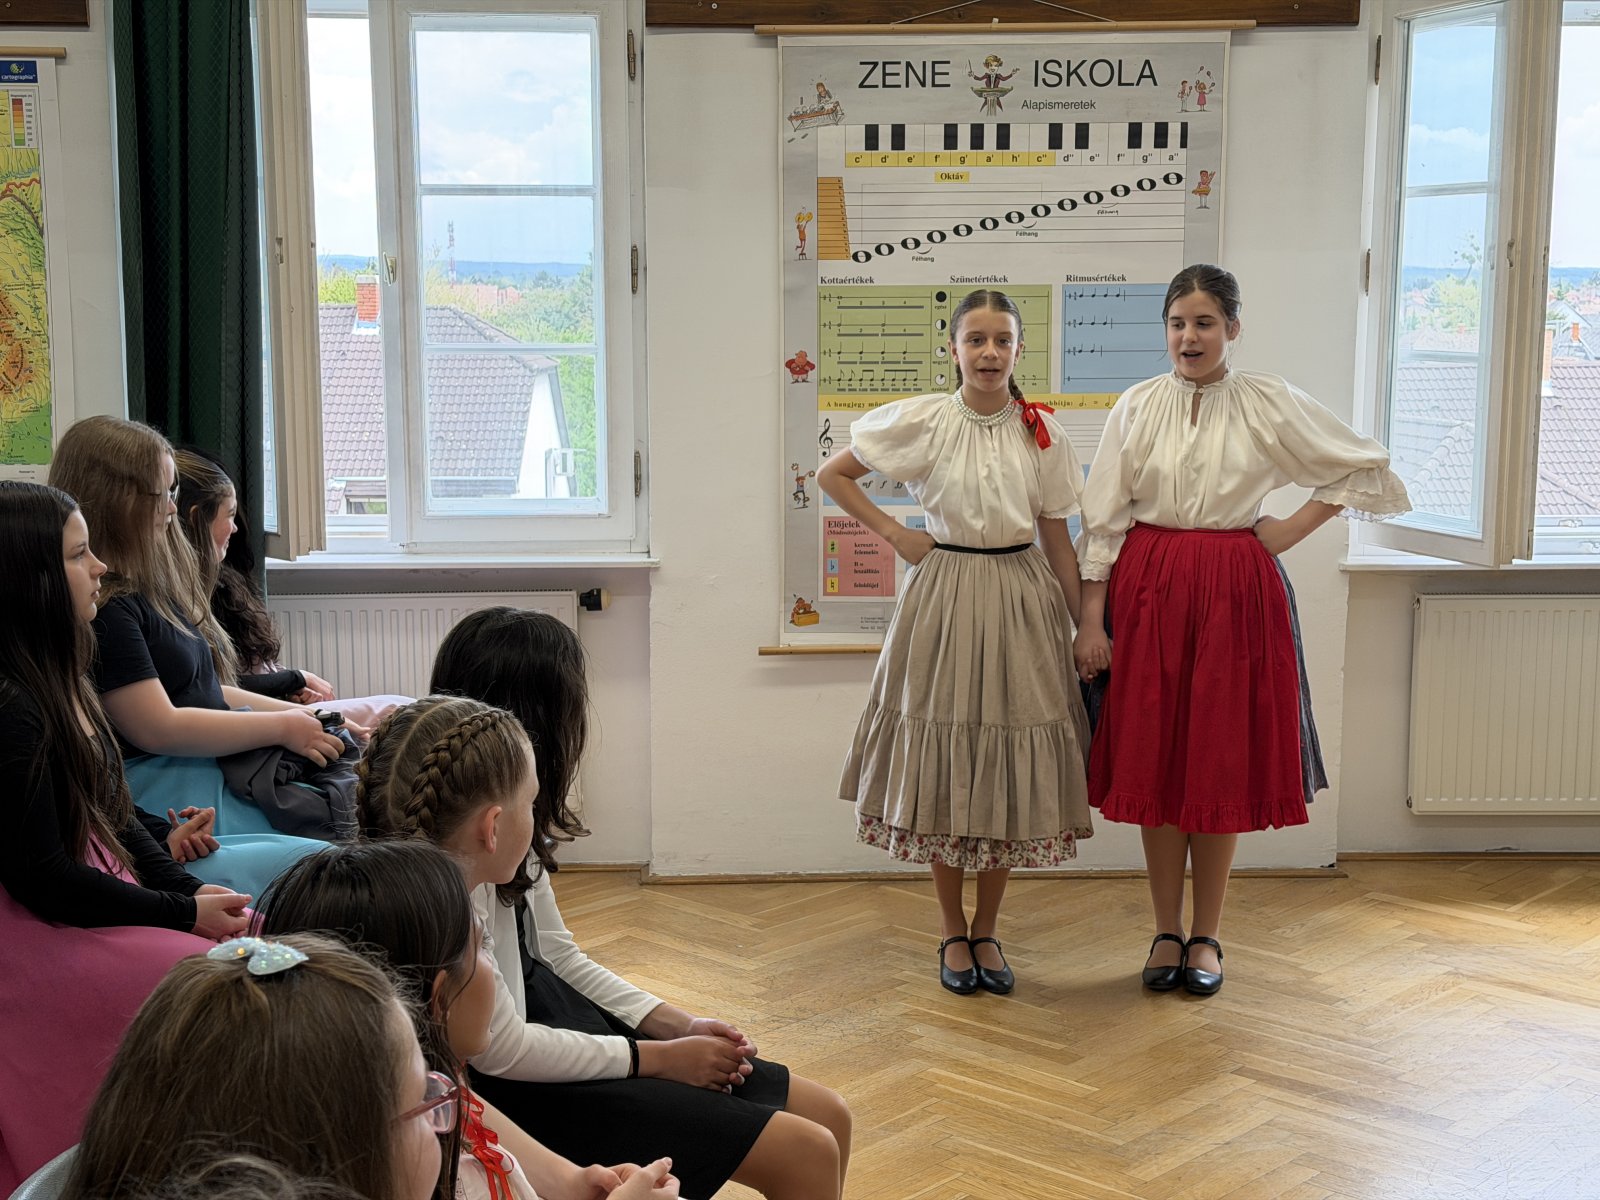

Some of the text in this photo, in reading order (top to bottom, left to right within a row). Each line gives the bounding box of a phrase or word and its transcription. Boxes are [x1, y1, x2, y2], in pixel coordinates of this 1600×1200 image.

[858, 58, 1158, 89] ZENE ISKOLA
[1021, 99, 1096, 112] Alapismeretek
[940, 172, 964, 180] Oktáv
[820, 276, 875, 285] Kottaértékek
[950, 274, 1009, 284] Szünetértékek
[1065, 274, 1127, 282] Ritmusértékek
[828, 520, 860, 529] Előjelek
